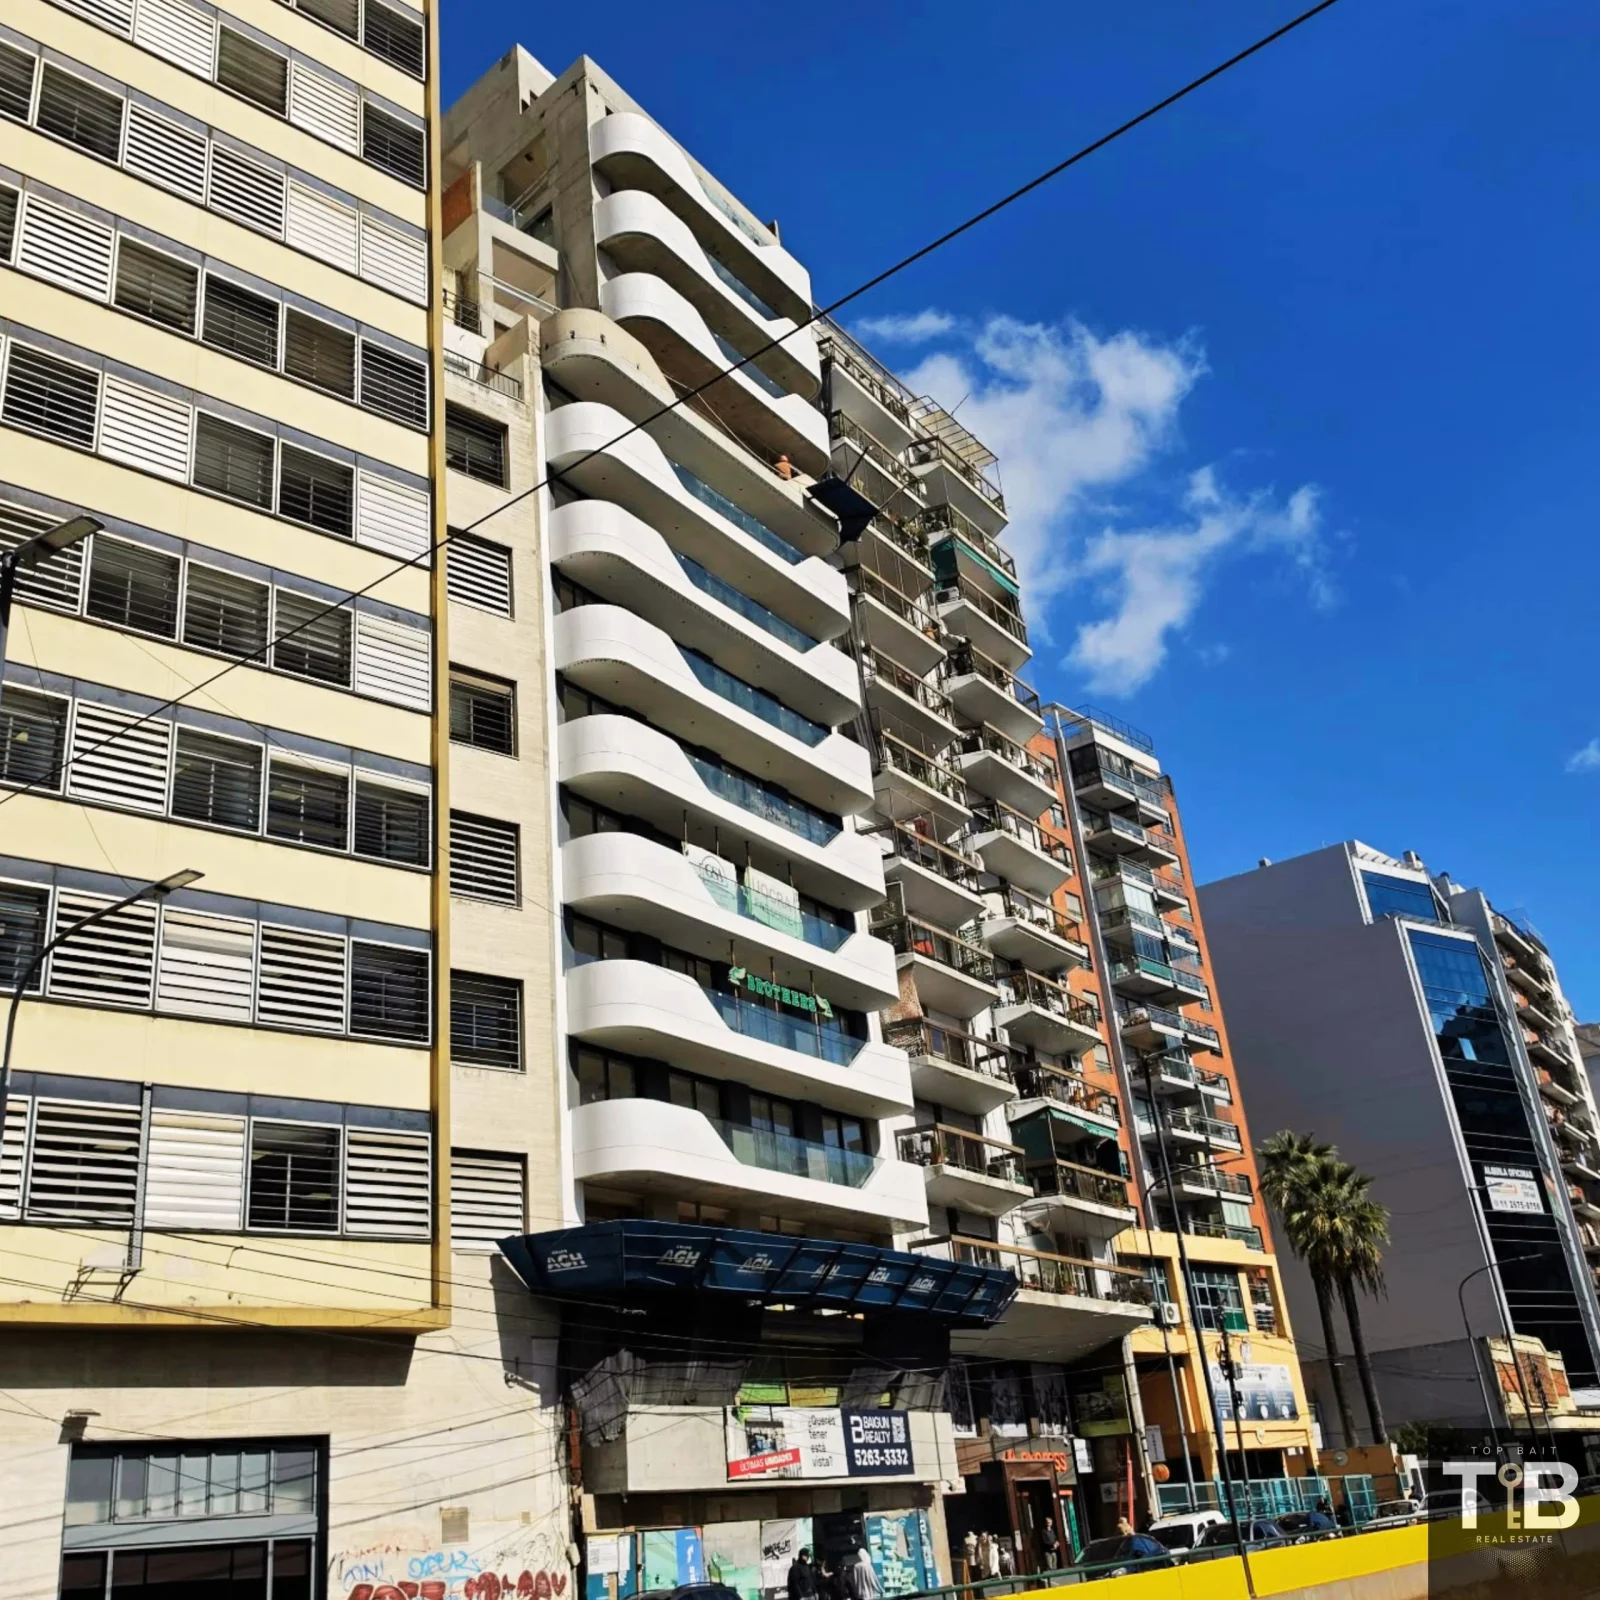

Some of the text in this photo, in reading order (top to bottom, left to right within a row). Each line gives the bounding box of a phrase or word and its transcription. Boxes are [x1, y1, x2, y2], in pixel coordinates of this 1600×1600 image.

[746, 973, 817, 1012] BROTHERS
[546, 1251, 586, 1270] AGH
[659, 1248, 701, 1265] AGH
[740, 1257, 773, 1270] AGH
[912, 1277, 936, 1289] AGH
[864, 1431, 891, 1443] REALTY
[854, 1448, 909, 1466] 5263-3332
